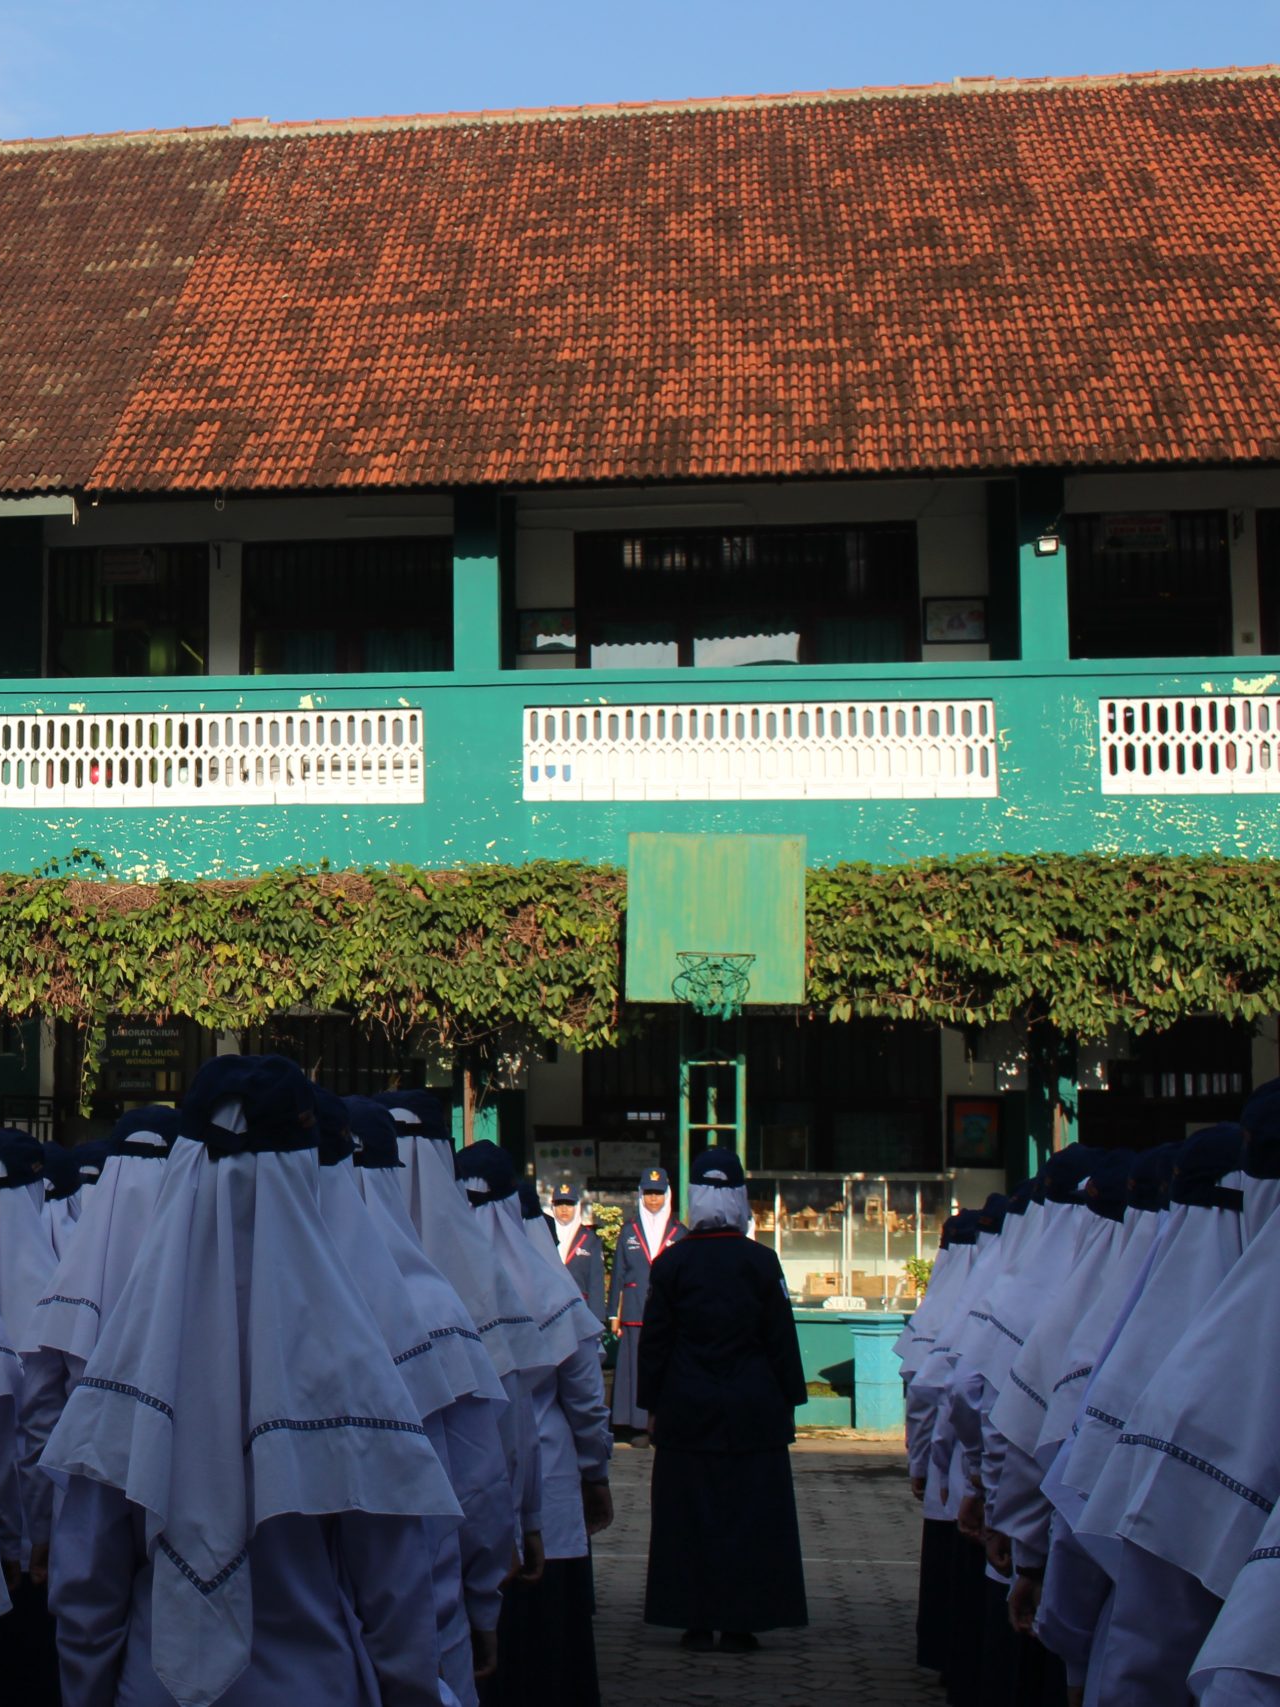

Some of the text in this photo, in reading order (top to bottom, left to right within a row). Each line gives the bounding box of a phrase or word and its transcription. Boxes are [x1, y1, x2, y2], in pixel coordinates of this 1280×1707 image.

[138, 1038, 153, 1046] IPA
[111, 1048, 180, 1057] SMP IT AL HUDA
